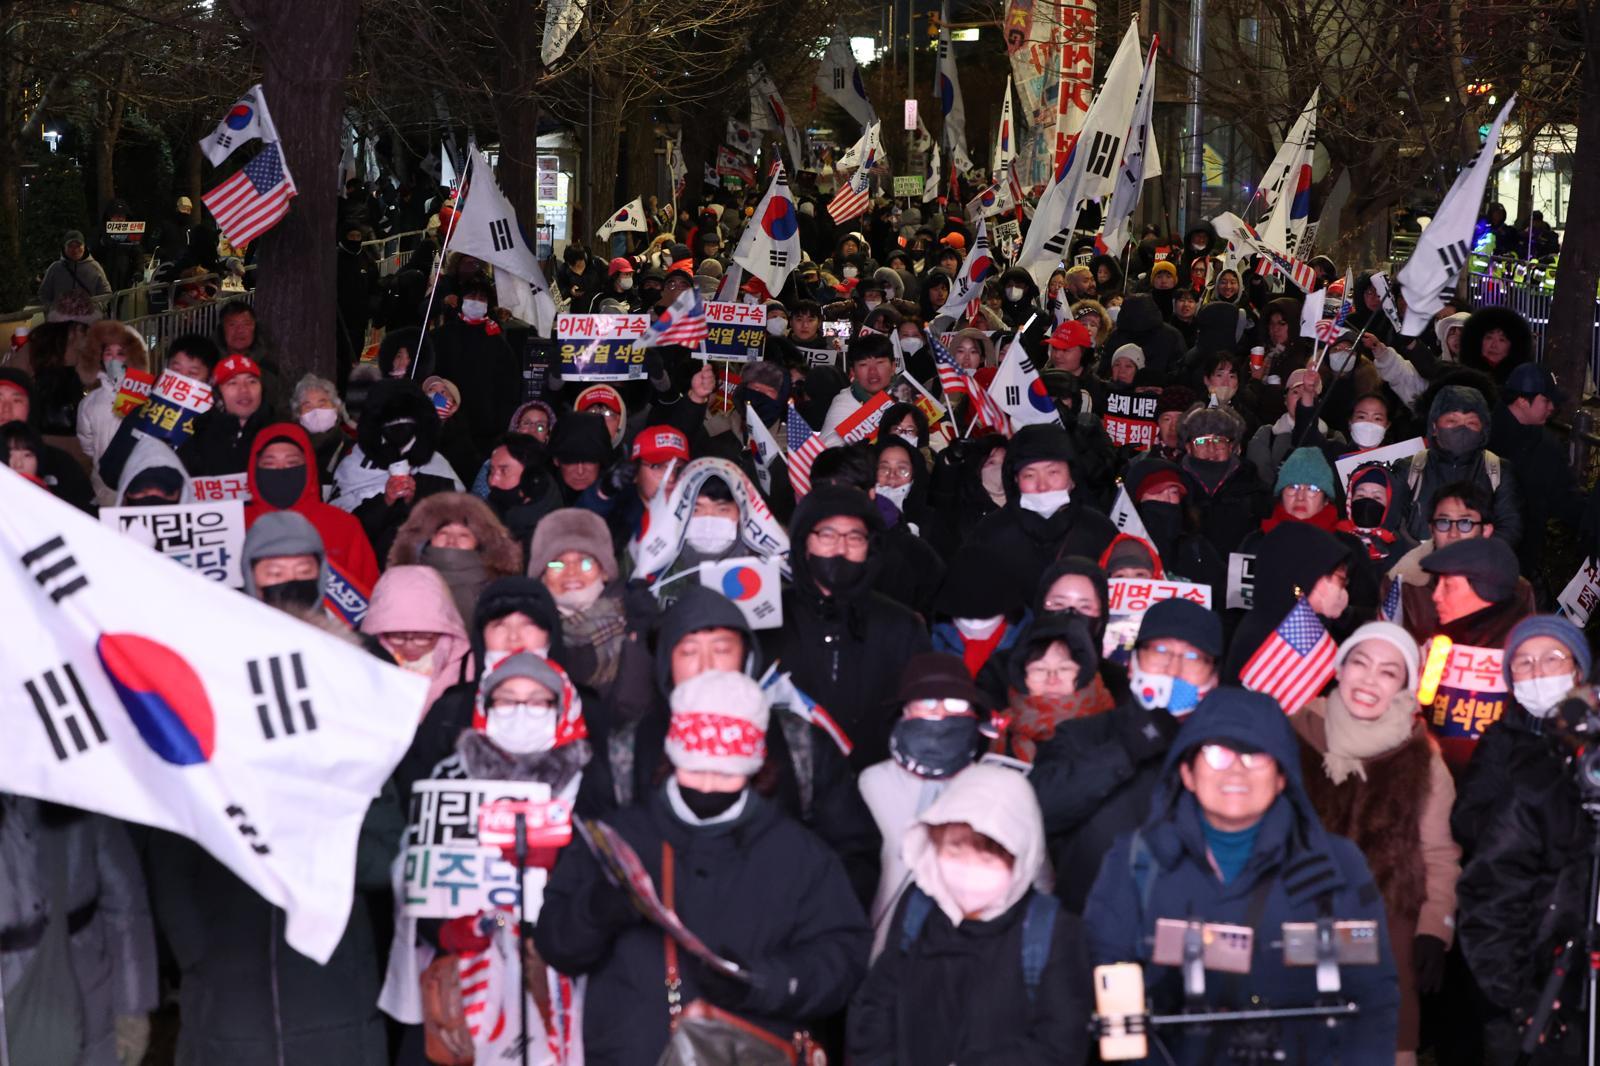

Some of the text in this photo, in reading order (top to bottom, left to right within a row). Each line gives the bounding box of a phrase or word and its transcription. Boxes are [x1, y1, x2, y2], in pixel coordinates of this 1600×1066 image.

[1107, 393, 1157, 418] 실제 내란
[1451, 698, 1503, 733] 석방
